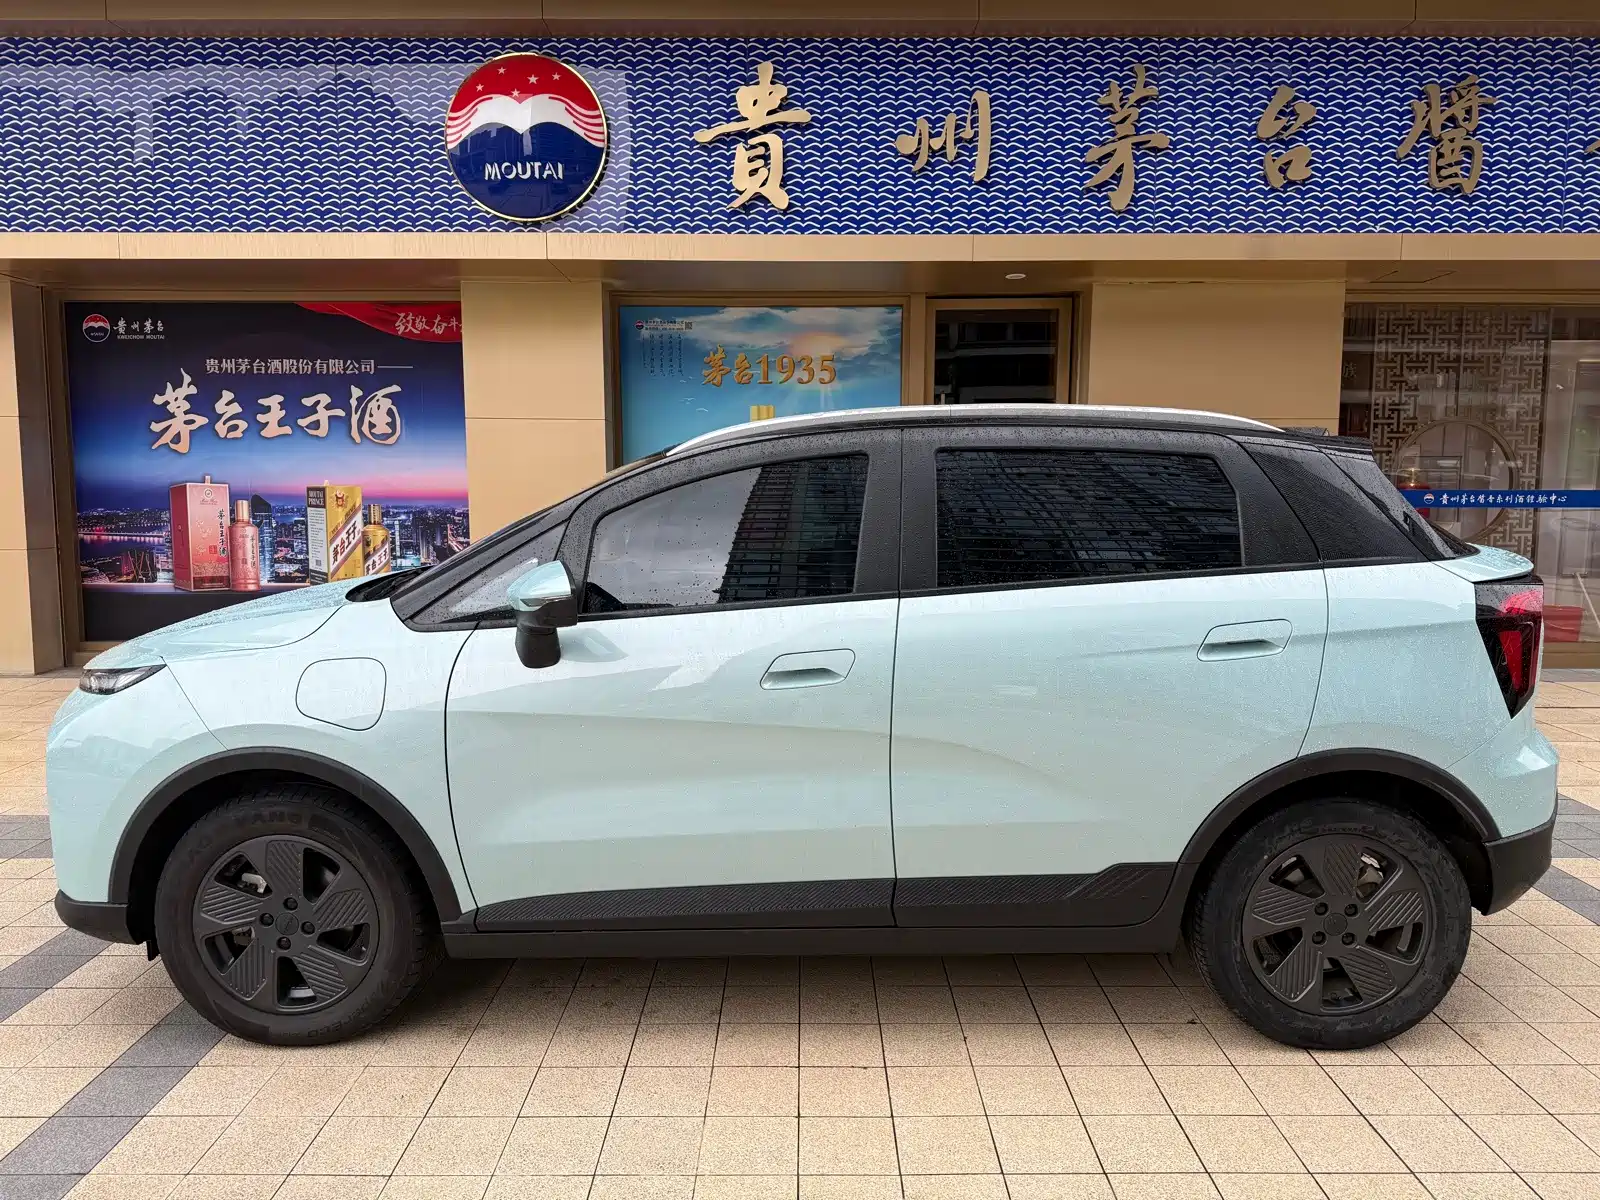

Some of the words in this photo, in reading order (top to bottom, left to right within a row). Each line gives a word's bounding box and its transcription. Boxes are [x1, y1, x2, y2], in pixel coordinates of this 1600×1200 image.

[484, 161, 565, 182] MOUTAI
[395, 312, 464, 335] 致敬奋斗
[204, 358, 376, 375] 贵州茅台酒股份有限公司
[702, 343, 837, 388] 茅台1935
[150, 367, 402, 454] 茅台王子酒
